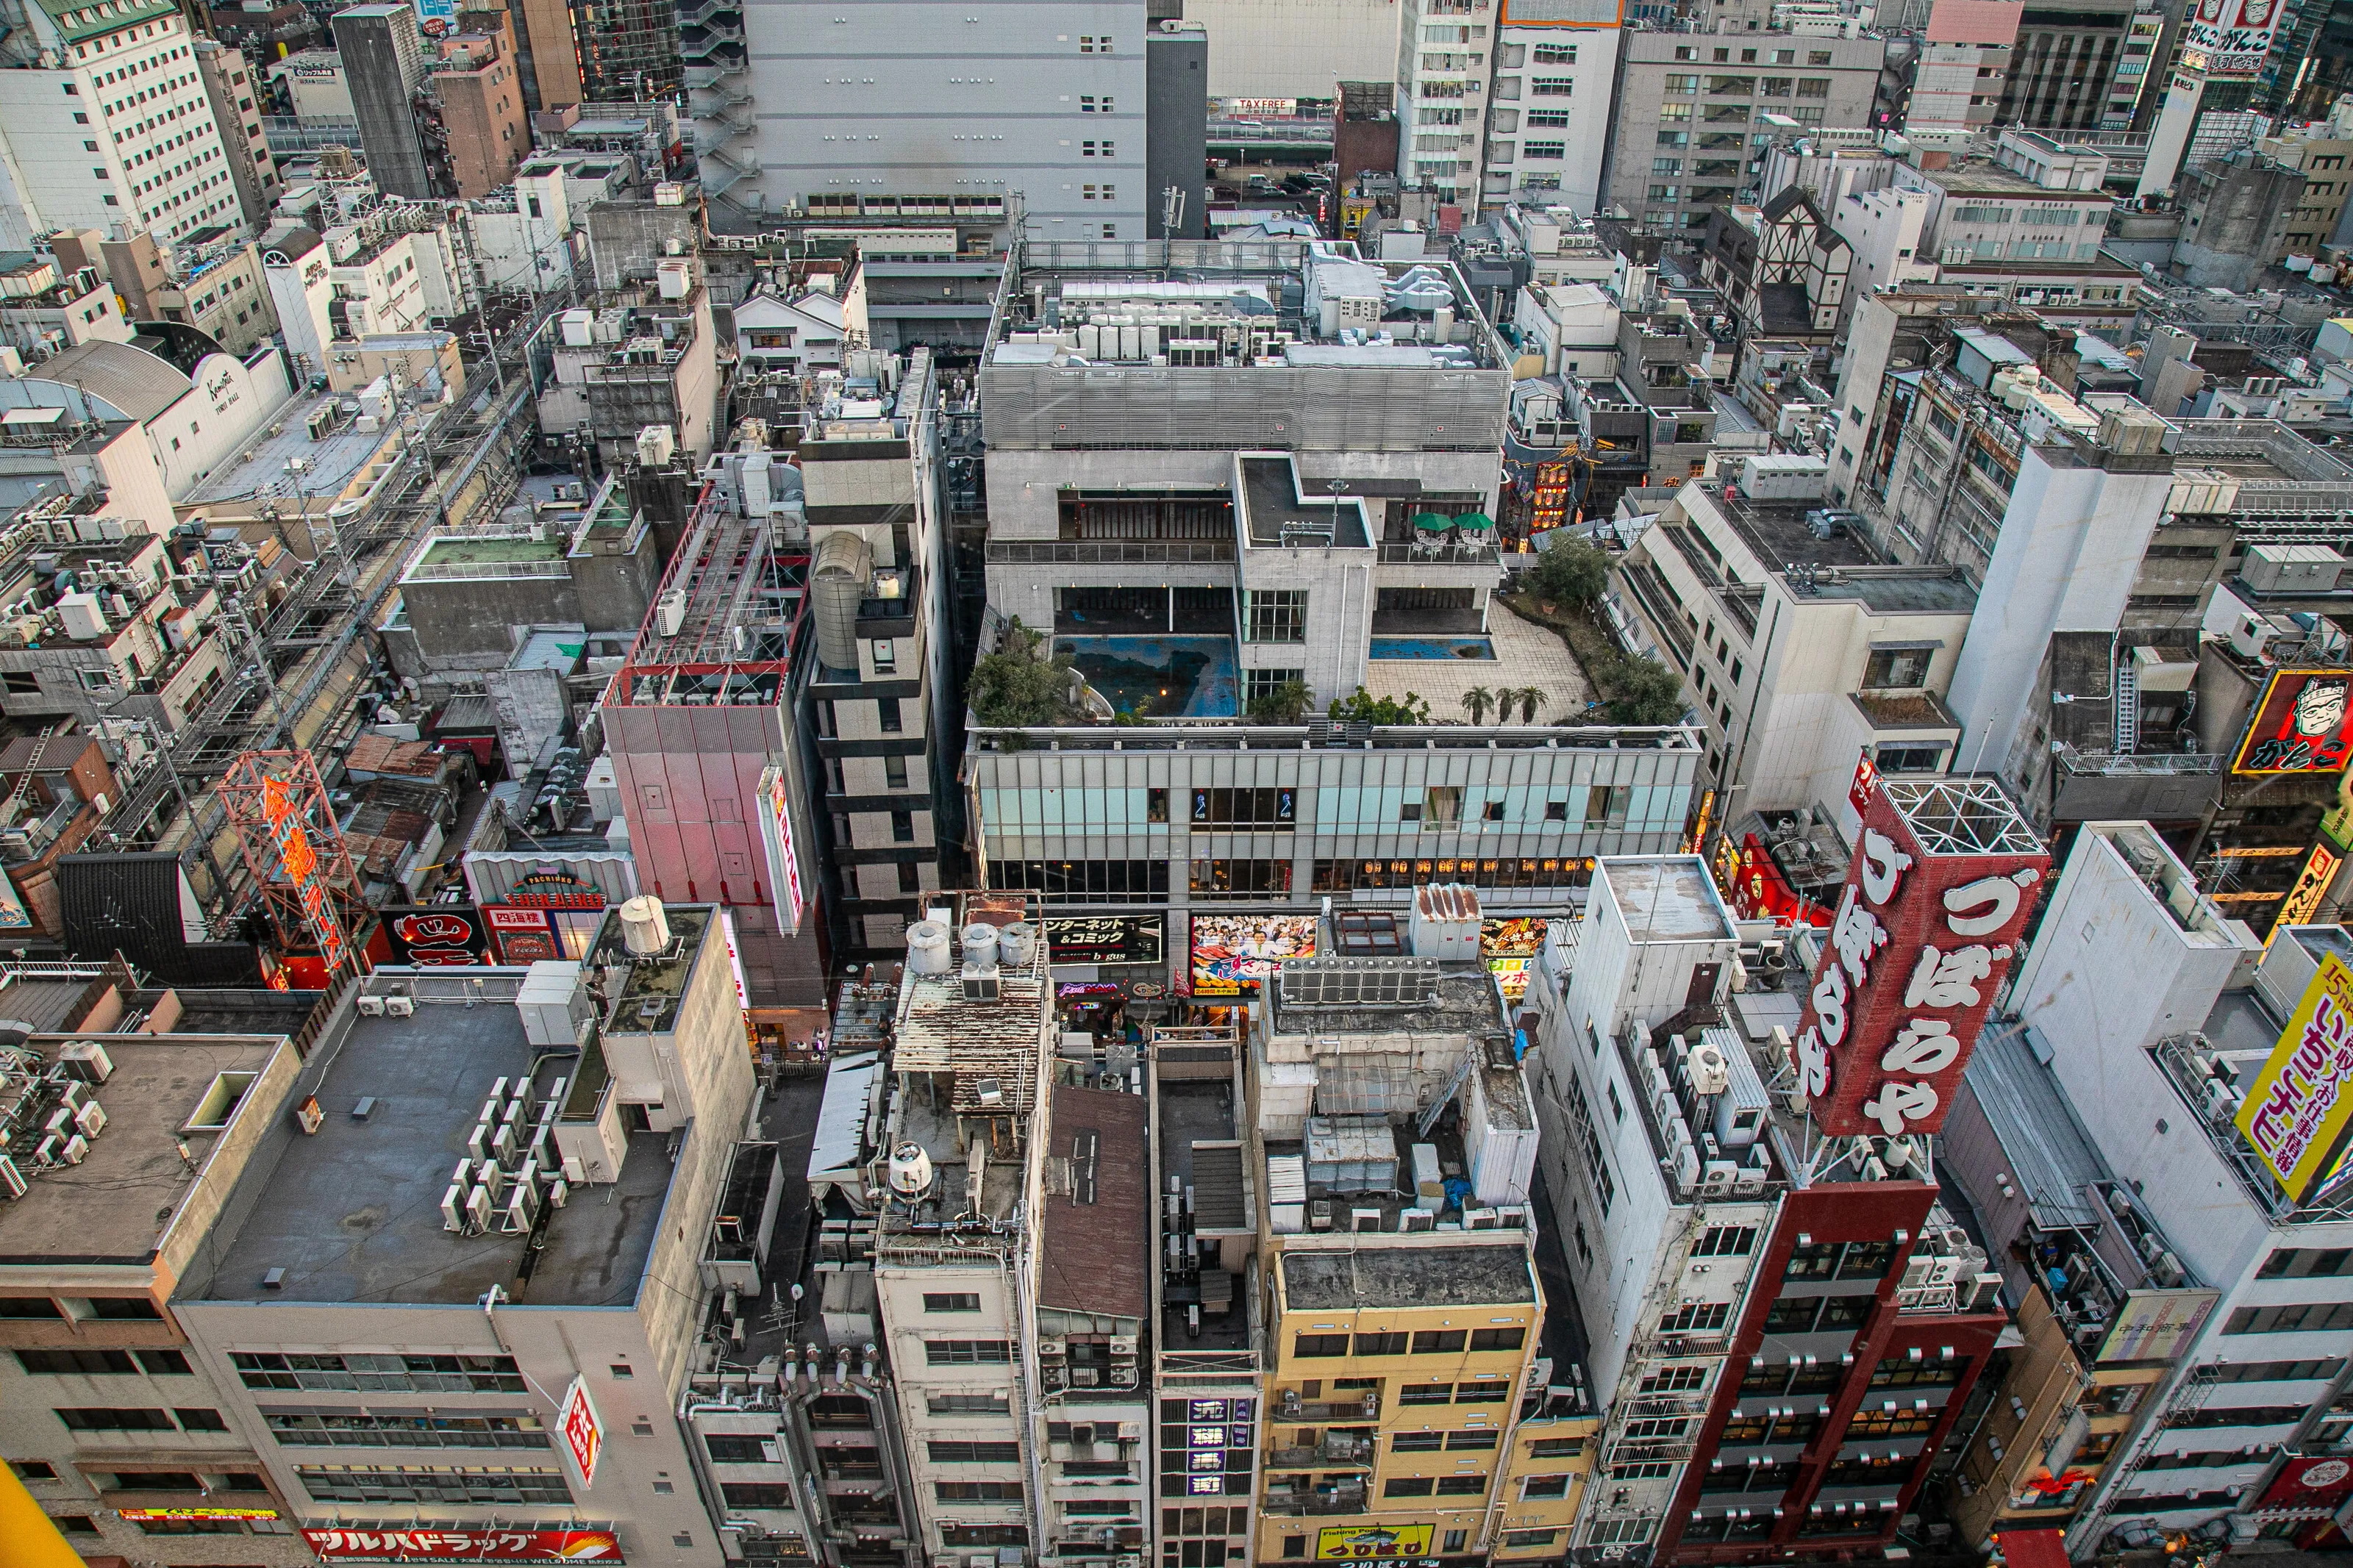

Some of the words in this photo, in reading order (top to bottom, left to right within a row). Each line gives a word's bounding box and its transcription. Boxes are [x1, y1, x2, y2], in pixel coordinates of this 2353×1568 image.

[2187, 23, 2218, 46] がんこ
[2218, 29, 2271, 51] がんこ
[1240, 100, 1260, 109] TAX
[1262, 100, 1286, 110] FREE
[228, 392, 240, 406] HALL
[2249, 739, 2346, 770] がんこ
[529, 876, 572, 884] PACHINKO
[1060, 931, 1124, 944] &コミック
[1863, 867, 2040, 1136] づぼらや
[307, 1531, 538, 1553] ツルハドラッグ
